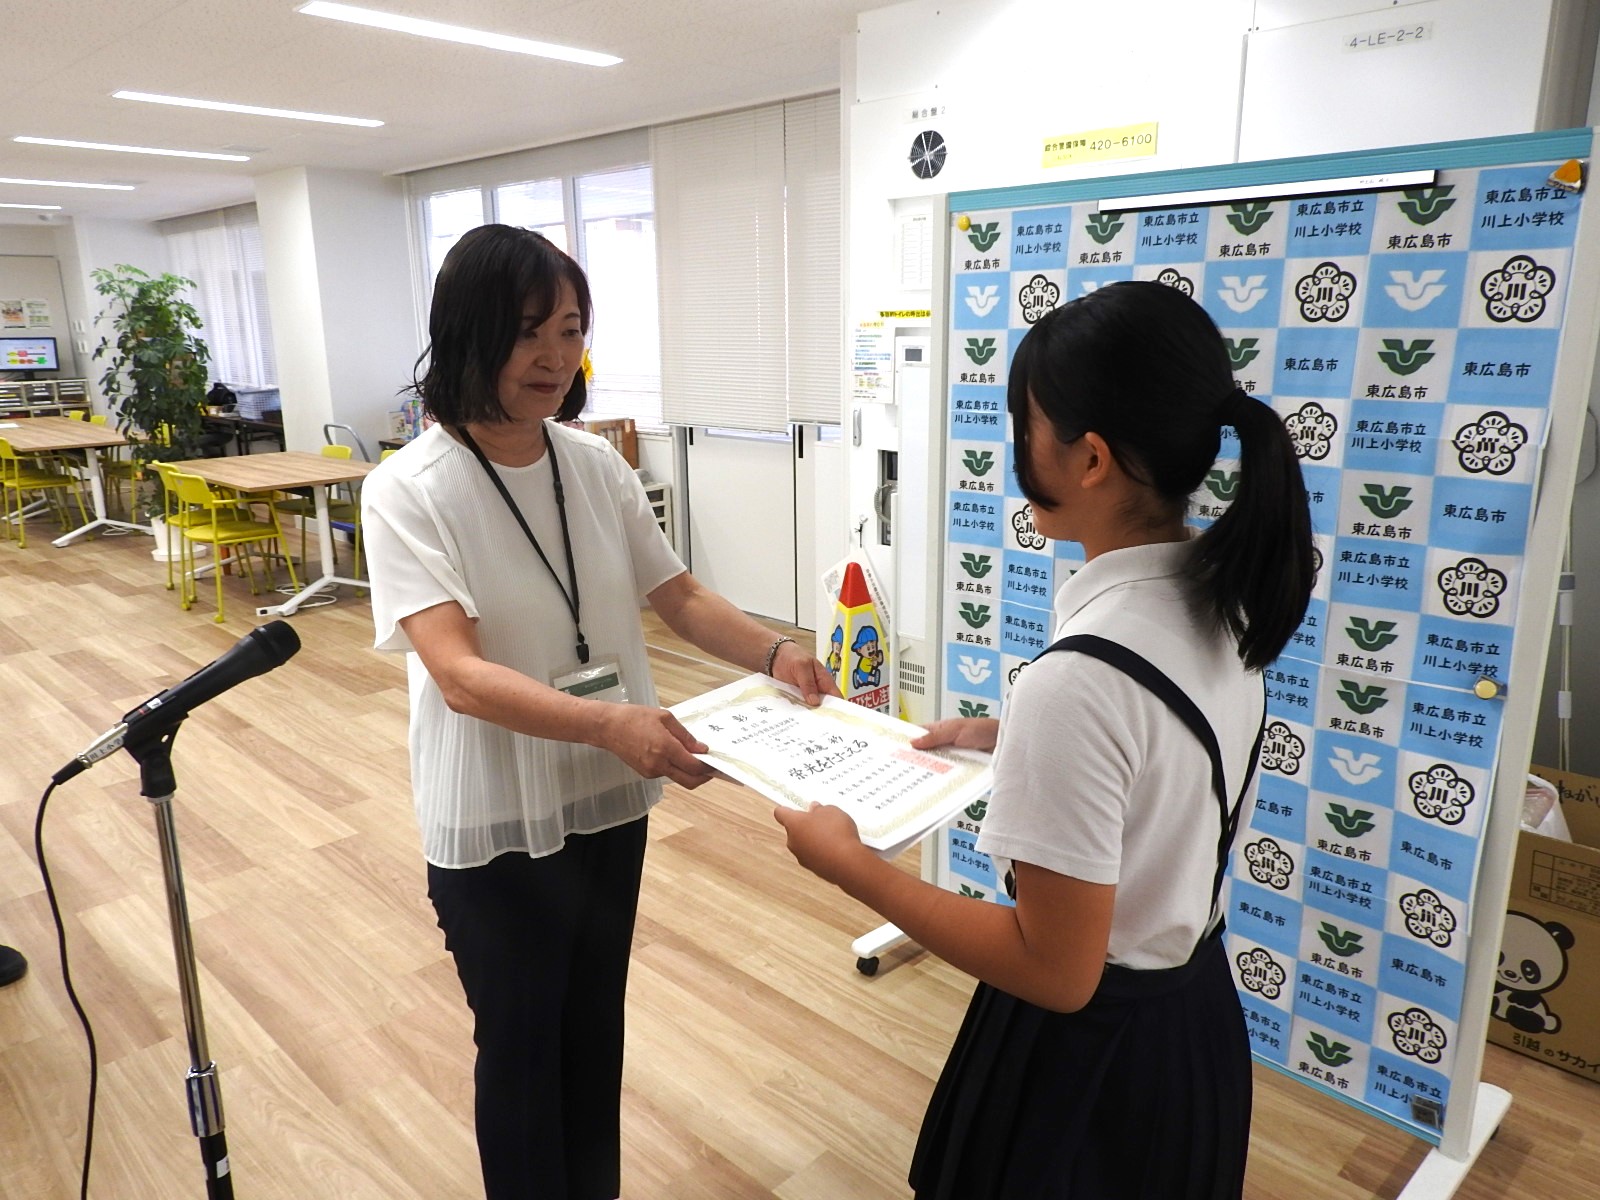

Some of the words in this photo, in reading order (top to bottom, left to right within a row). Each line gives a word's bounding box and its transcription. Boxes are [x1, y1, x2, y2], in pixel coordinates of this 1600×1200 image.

[1350, 26, 1424, 49] 4-LE-2-2
[1090, 133, 1152, 151] 420-6100
[1485, 187, 1568, 204] 東広島市立
[1297, 200, 1364, 216] 東広島市立
[1144, 212, 1200, 227] 東広島市立
[1481, 211, 1565, 228] 川上小学校
[1016, 223, 1063, 237] 東広島市立
[1294, 222, 1362, 238] 川上小学校
[1015, 241, 1061, 255] 川上小学校
[1141, 233, 1198, 247] 川上小学校
[1387, 233, 1453, 249] 東広島市
[1079, 251, 1123, 264] 東広島市
[1218, 242, 1272, 257] 東広島市
[964, 258, 1001, 271] 東広島市
[1284, 357, 1339, 372] 東広島市
[1462, 361, 1531, 378] 東広島市
[960, 373, 996, 385] 東広島市
[1366, 384, 1428, 400] 東広島市
[955, 400, 998, 411] 東広島市立
[954, 414, 998, 426] 川上小学校
[1355, 419, 1427, 436] 東広島市立
[1351, 437, 1422, 454] 川上小学校
[959, 480, 995, 492] 東広島市
[953, 502, 996, 515] 東広島市立
[1444, 503, 1507, 524] 東広島市
[952, 518, 995, 532] 川上小学校
[1351, 522, 1412, 540] 東広島市
[1339, 551, 1410, 569] 東広島市立
[1007, 564, 1048, 580] 東広島市立
[1337, 571, 1409, 590] 川上小学校
[955, 581, 992, 595] 東広島市
[1007, 580, 1047, 597] 川上小学校
[1005, 615, 1044, 633] 東広島市立
[956, 632, 992, 646] 東広島市
[1004, 631, 1045, 649] 川上小学校
[1425, 633, 1501, 656] 東広島市立
[1336, 653, 1395, 673] 東広島市
[1422, 654, 1499, 678] 川上小学校
[1264, 669, 1310, 689] 広島市立
[1265, 687, 1309, 709] 上小学校
[1411, 702, 1487, 727] 東広島市立
[1329, 717, 1385, 739] 東広島市
[1410, 721, 1484, 748] 川上小学校
[788, 739, 868, 780] 栄光をたたえる
[1255, 798, 1293, 817] 広島市
[957, 820, 981, 834] 東広島
[1317, 839, 1372, 861] 東広島市
[1401, 841, 1453, 871] 東広島市
[952, 851, 990, 872] 川上小学校
[1309, 866, 1373, 893] 東広島市立
[1308, 880, 1372, 910] 川上小学校
[1239, 901, 1286, 927] 東広島市
[1309, 953, 1363, 979] 東広島市
[1390, 958, 1448, 988] 東広島市
[1300, 973, 1362, 1004] 東広島市立
[1298, 990, 1361, 1023] 川上小学校
[1298, 1061, 1350, 1090] 東広島市
[1376, 1064, 1442, 1099] 東広島市立
